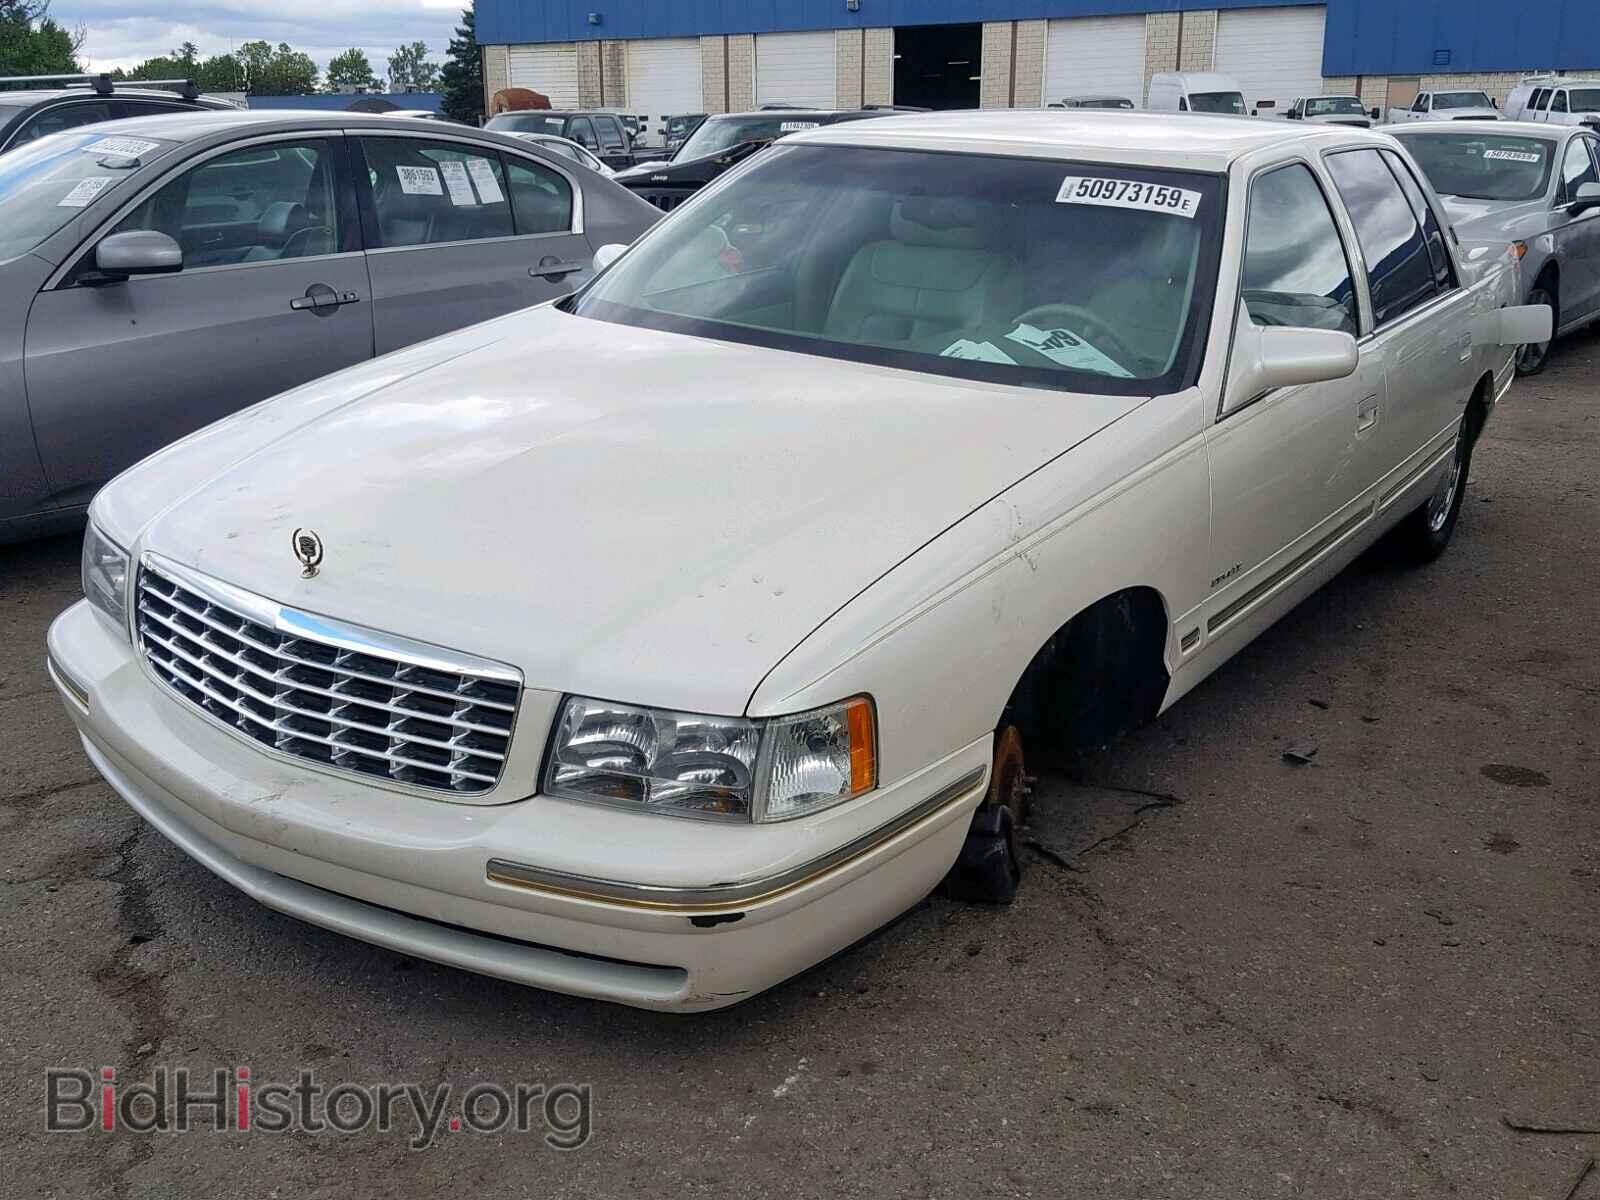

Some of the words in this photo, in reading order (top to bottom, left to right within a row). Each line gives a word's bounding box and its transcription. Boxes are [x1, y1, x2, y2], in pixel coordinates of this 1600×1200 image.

[651, 174, 668, 182] Jeep
[1076, 178, 1183, 208] 50973159
[1182, 200, 1191, 210] E
